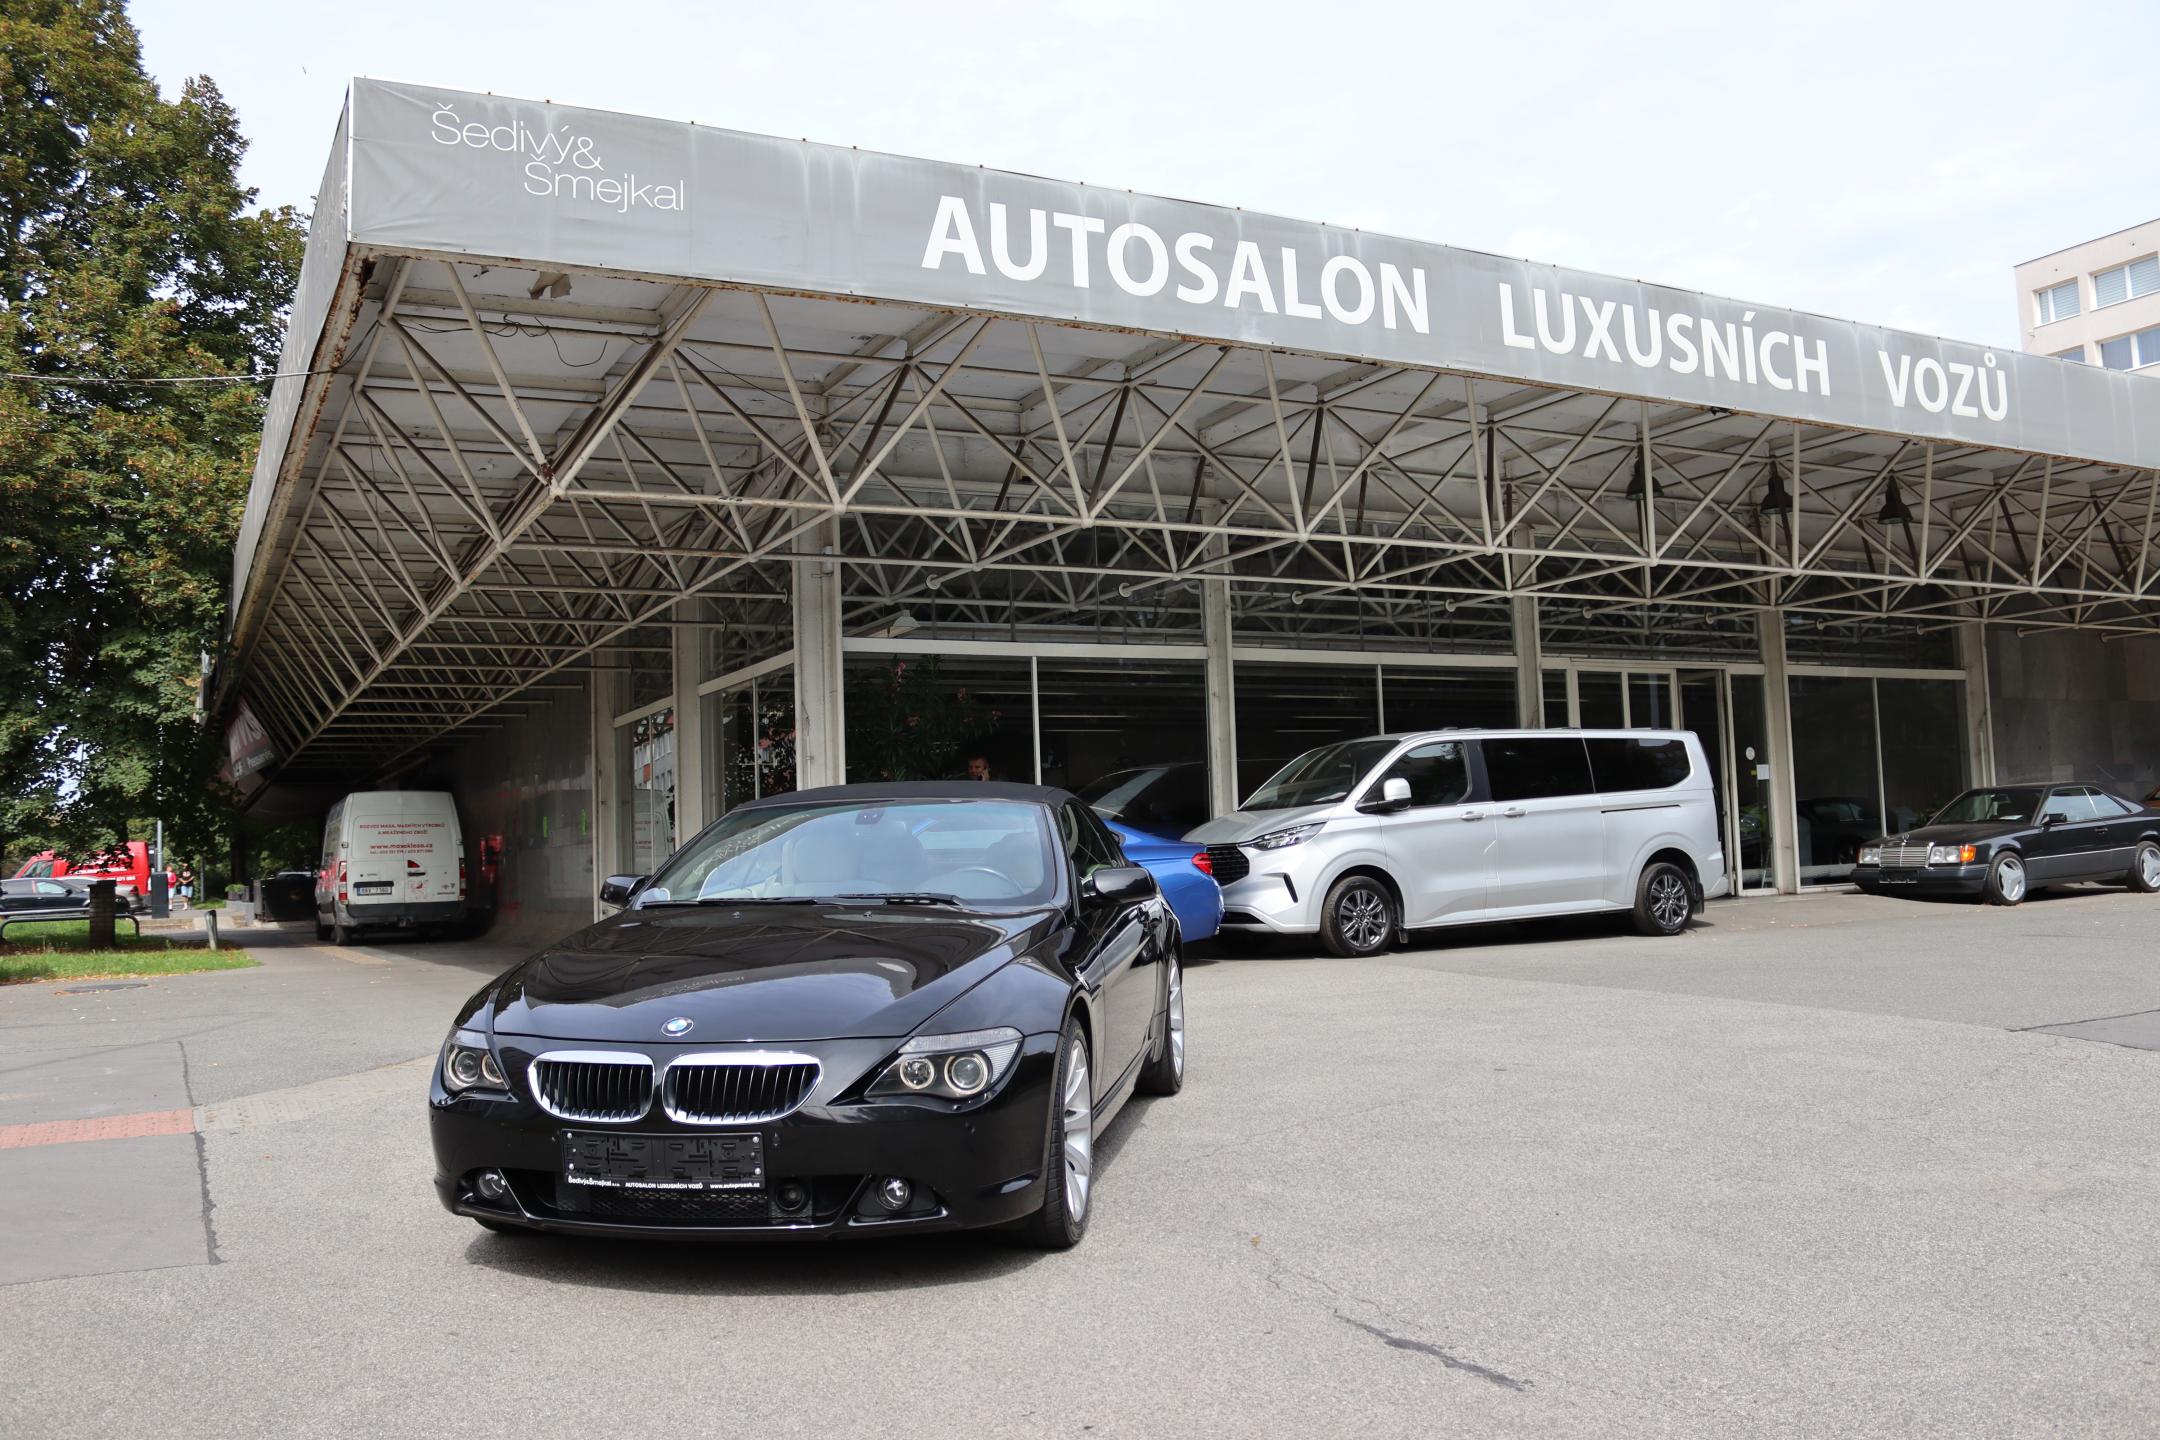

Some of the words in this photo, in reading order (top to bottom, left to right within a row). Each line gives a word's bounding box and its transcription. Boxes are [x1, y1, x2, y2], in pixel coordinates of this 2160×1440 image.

[430, 102, 605, 171] Šedivý&
[523, 153, 684, 213] Šmejkal
[921, 195, 1430, 335] AUTOSALON
[1499, 282, 1831, 396] LUXUSNÍCH
[1878, 350, 2009, 422] VOZŮ
